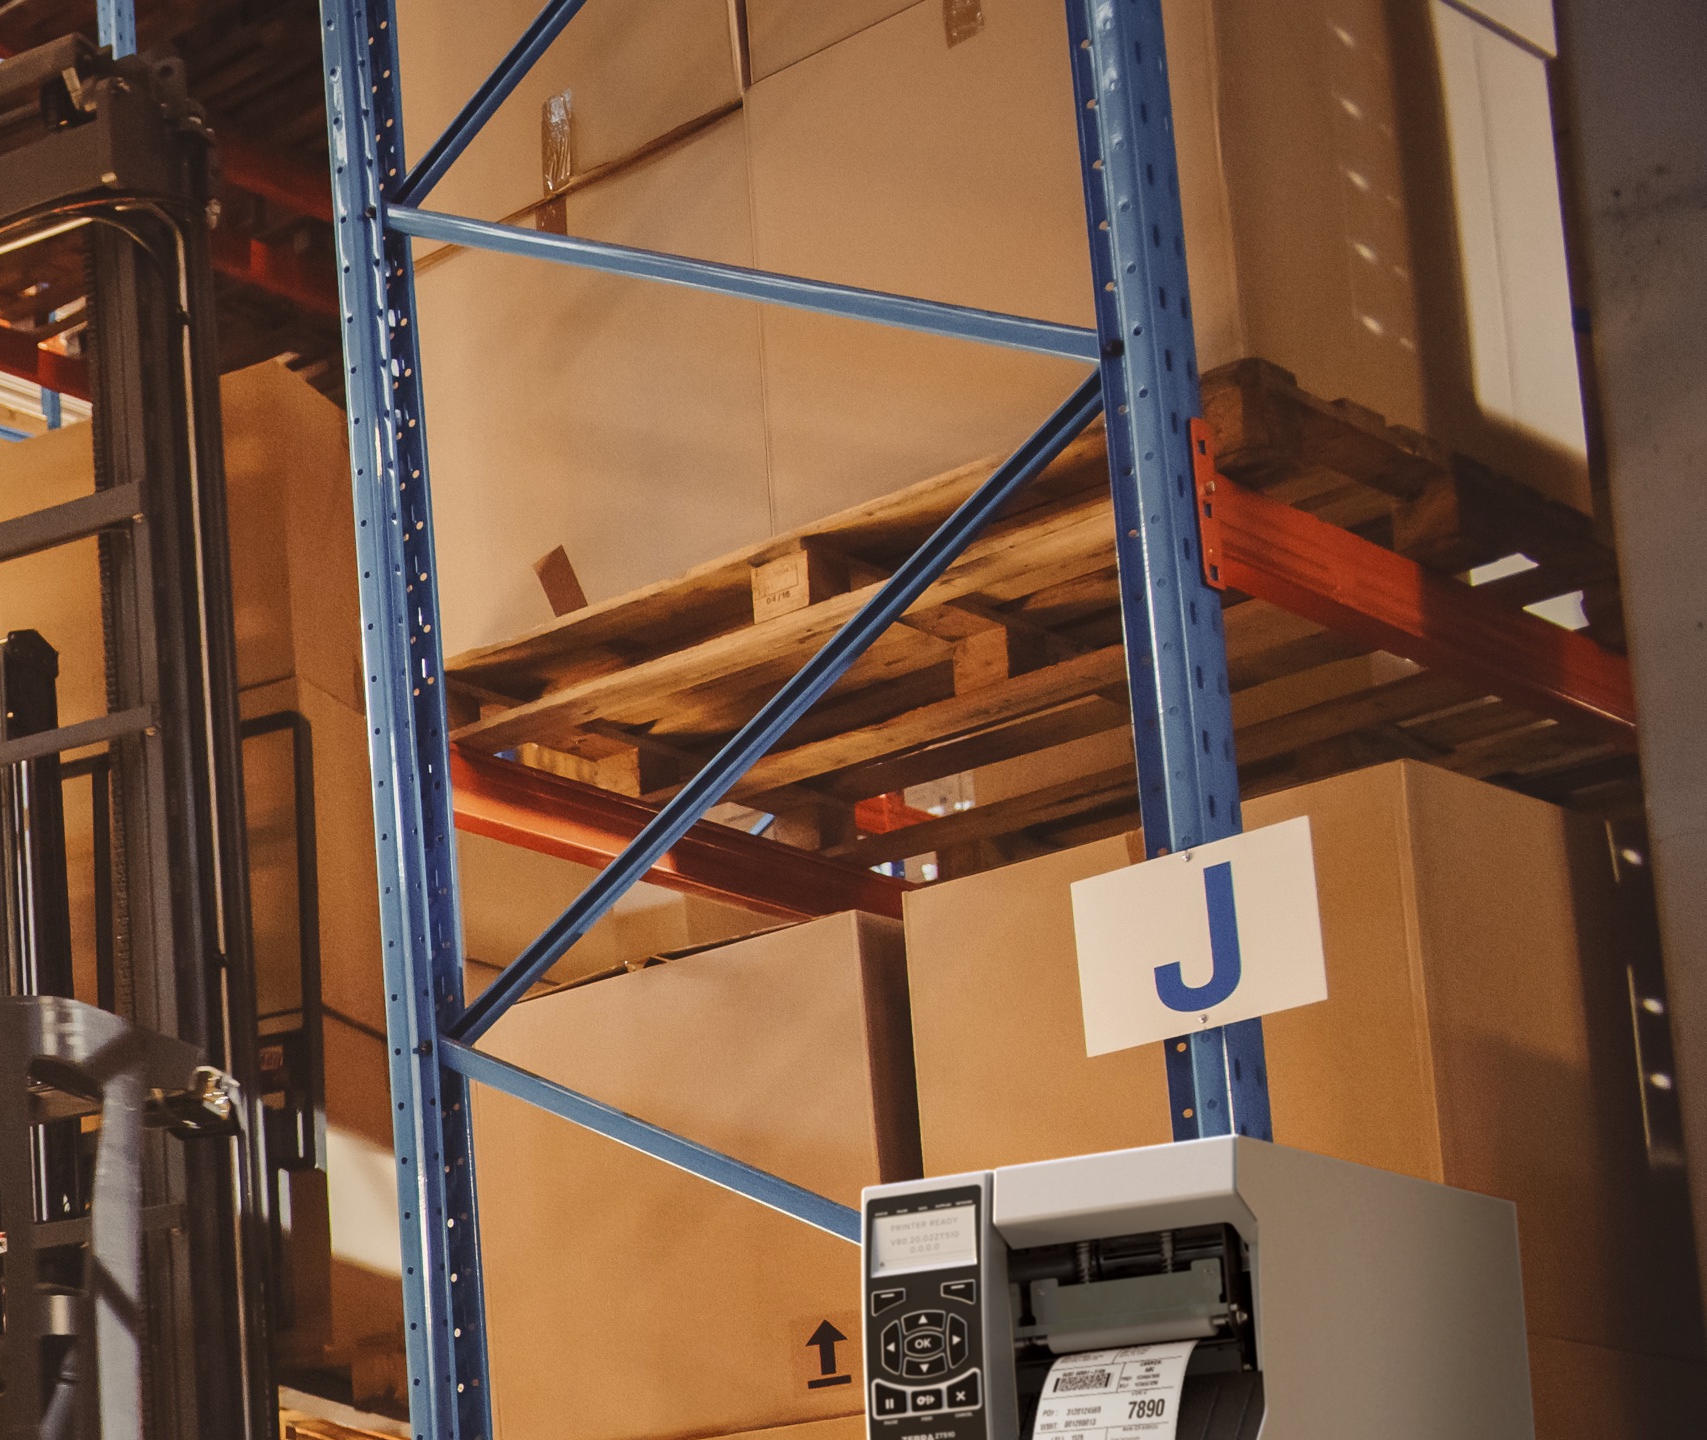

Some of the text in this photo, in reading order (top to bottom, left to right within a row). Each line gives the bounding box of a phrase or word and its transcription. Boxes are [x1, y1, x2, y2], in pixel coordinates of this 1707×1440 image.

[1153, 860, 1242, 1012] J
[890, 1217, 958, 1232] PRINTER READY
[914, 1338, 932, 1349] OK
[1128, 1398, 1165, 1420] 7890
[935, 1431, 956, 1440] ZT510
